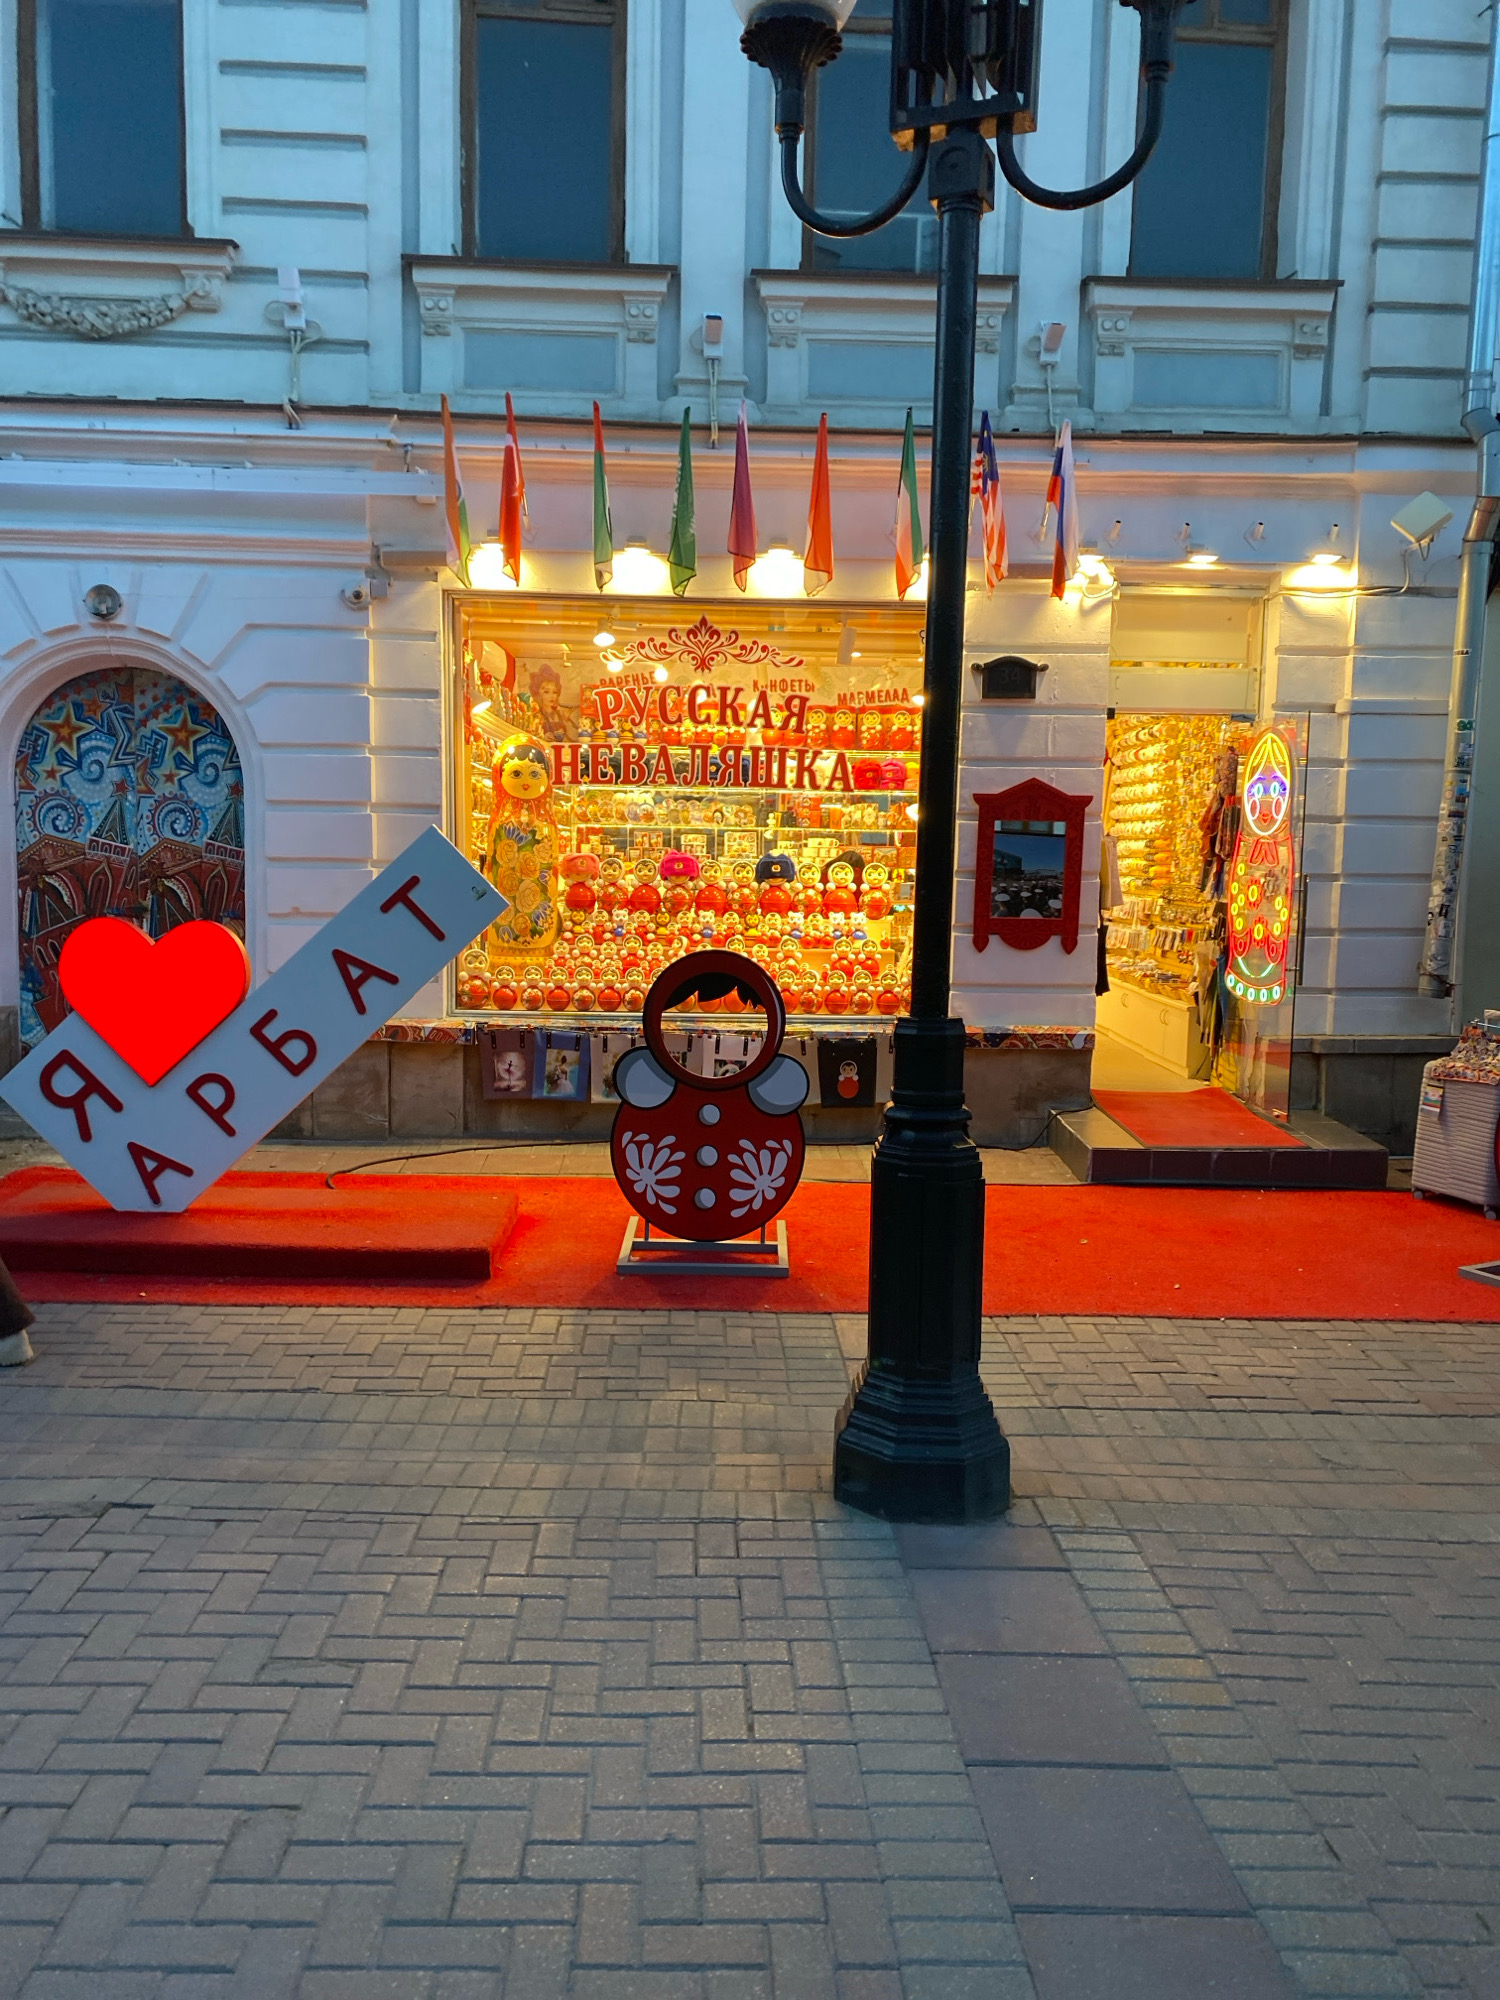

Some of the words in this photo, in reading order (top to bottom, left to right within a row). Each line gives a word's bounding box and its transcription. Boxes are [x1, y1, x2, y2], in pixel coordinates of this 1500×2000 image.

[753, 678, 815, 692] КНФЕТЫ
[837, 687, 911, 706] МАРМЕЛАД
[1000, 667, 1021, 684] 34
[593, 684, 810, 735] РУССКАЯ
[551, 744, 855, 792] НЕВАЛЯШКА
[127, 875, 446, 1205] АРБАТ
[40, 1049, 124, 1142] Я
